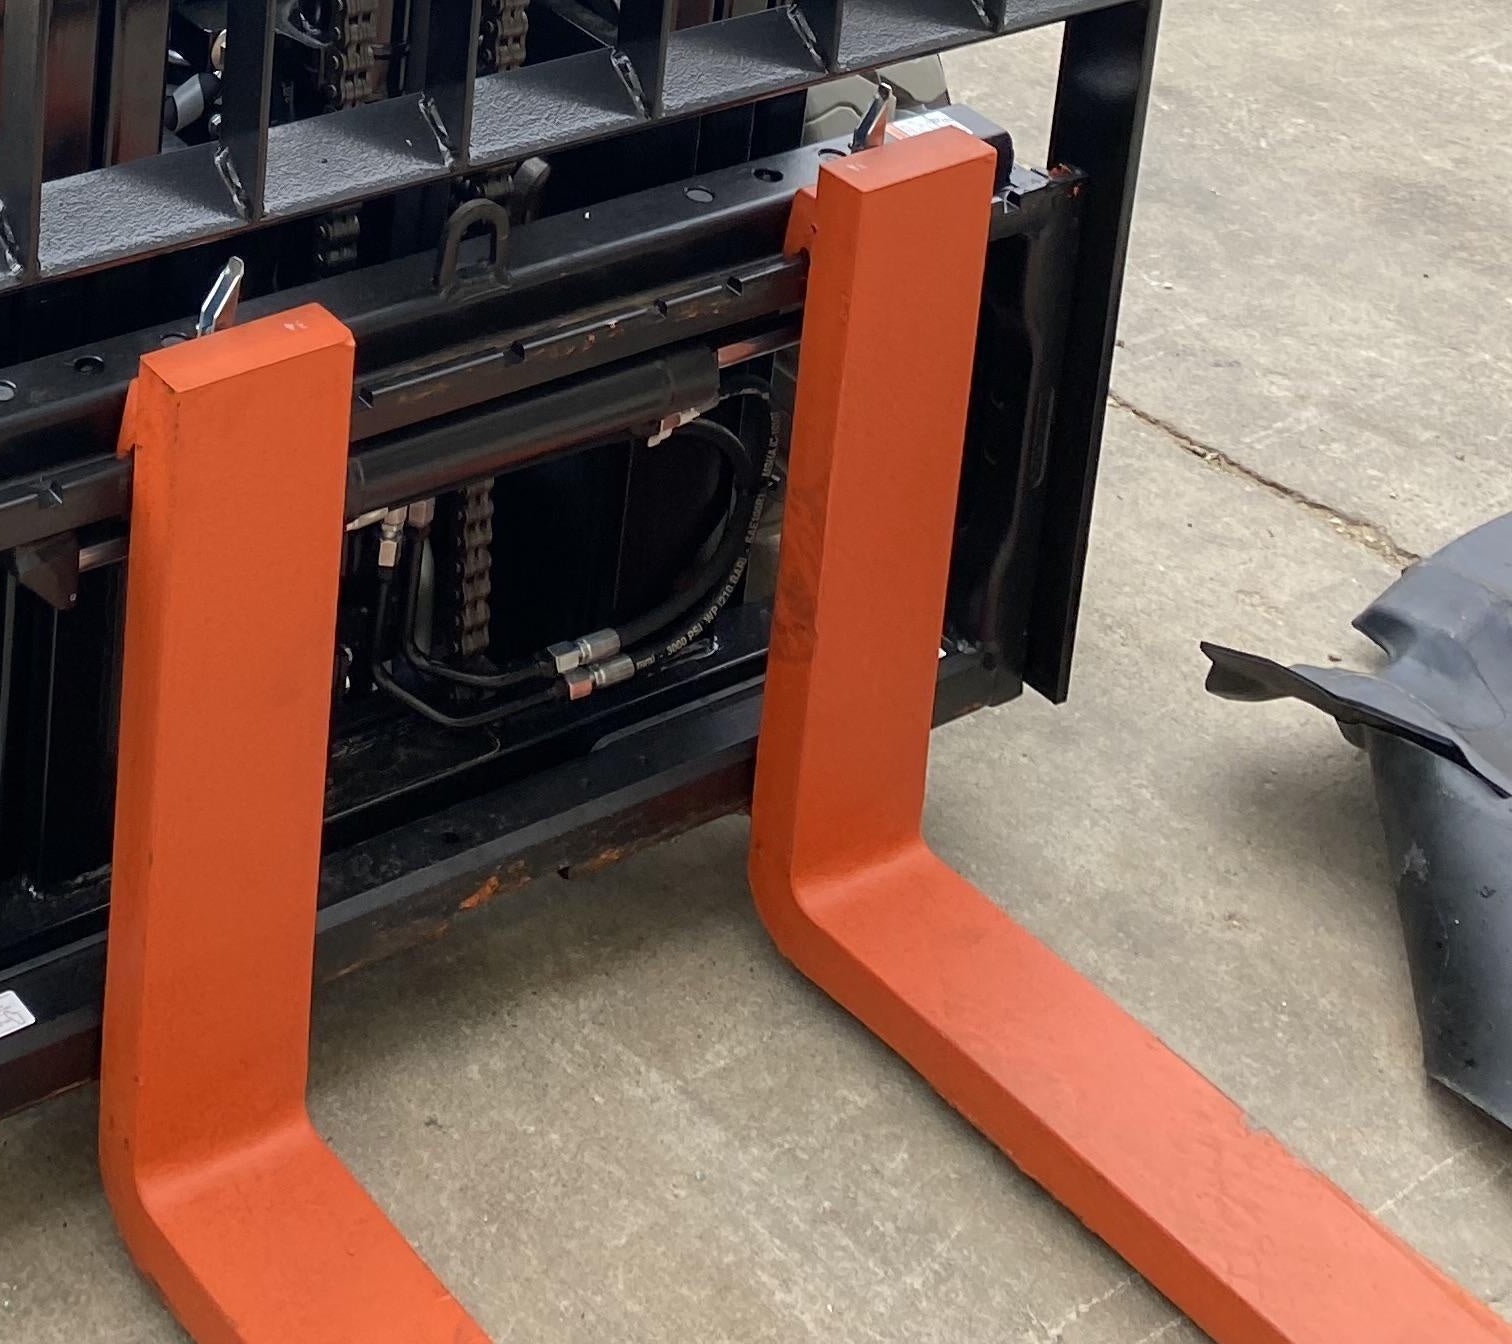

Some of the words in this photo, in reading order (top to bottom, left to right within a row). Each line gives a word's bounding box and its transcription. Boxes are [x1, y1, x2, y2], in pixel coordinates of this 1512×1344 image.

[666, 636, 687, 656] 3000
[687, 622, 704, 641] PSI
[703, 605, 719, 623] WP
